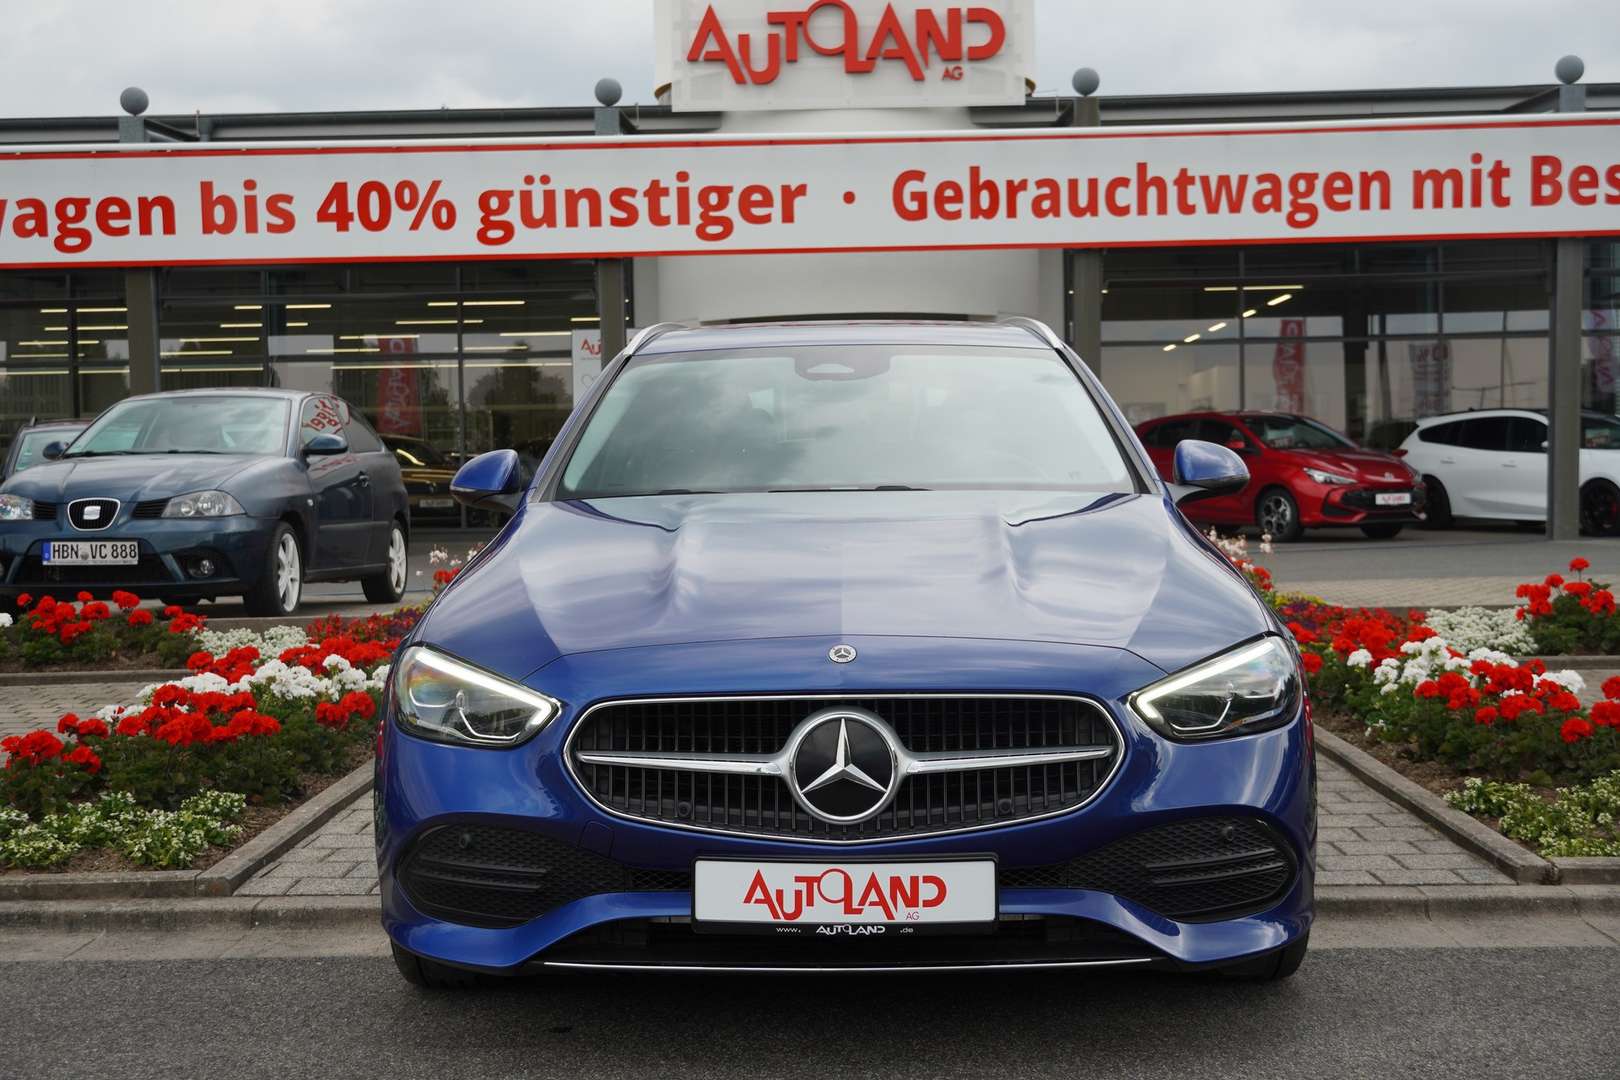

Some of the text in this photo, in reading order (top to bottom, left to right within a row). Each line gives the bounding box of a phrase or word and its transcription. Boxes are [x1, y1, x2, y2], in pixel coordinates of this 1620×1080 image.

[688, 0, 1006, 84] AUTOLAND
[942, 66, 964, 81] AG
[200, 179, 296, 235] bis
[316, 179, 457, 233] 40%
[476, 171, 808, 246] günstiger
[892, 162, 1391, 230] Gebrauchtwagen
[1412, 153, 1511, 209] mit
[52, 544, 137, 559] HBN VC 888
[743, 868, 946, 920] AUTOLAND
[905, 911, 920, 921] AG
[815, 924, 886, 936] AUTOLAND
